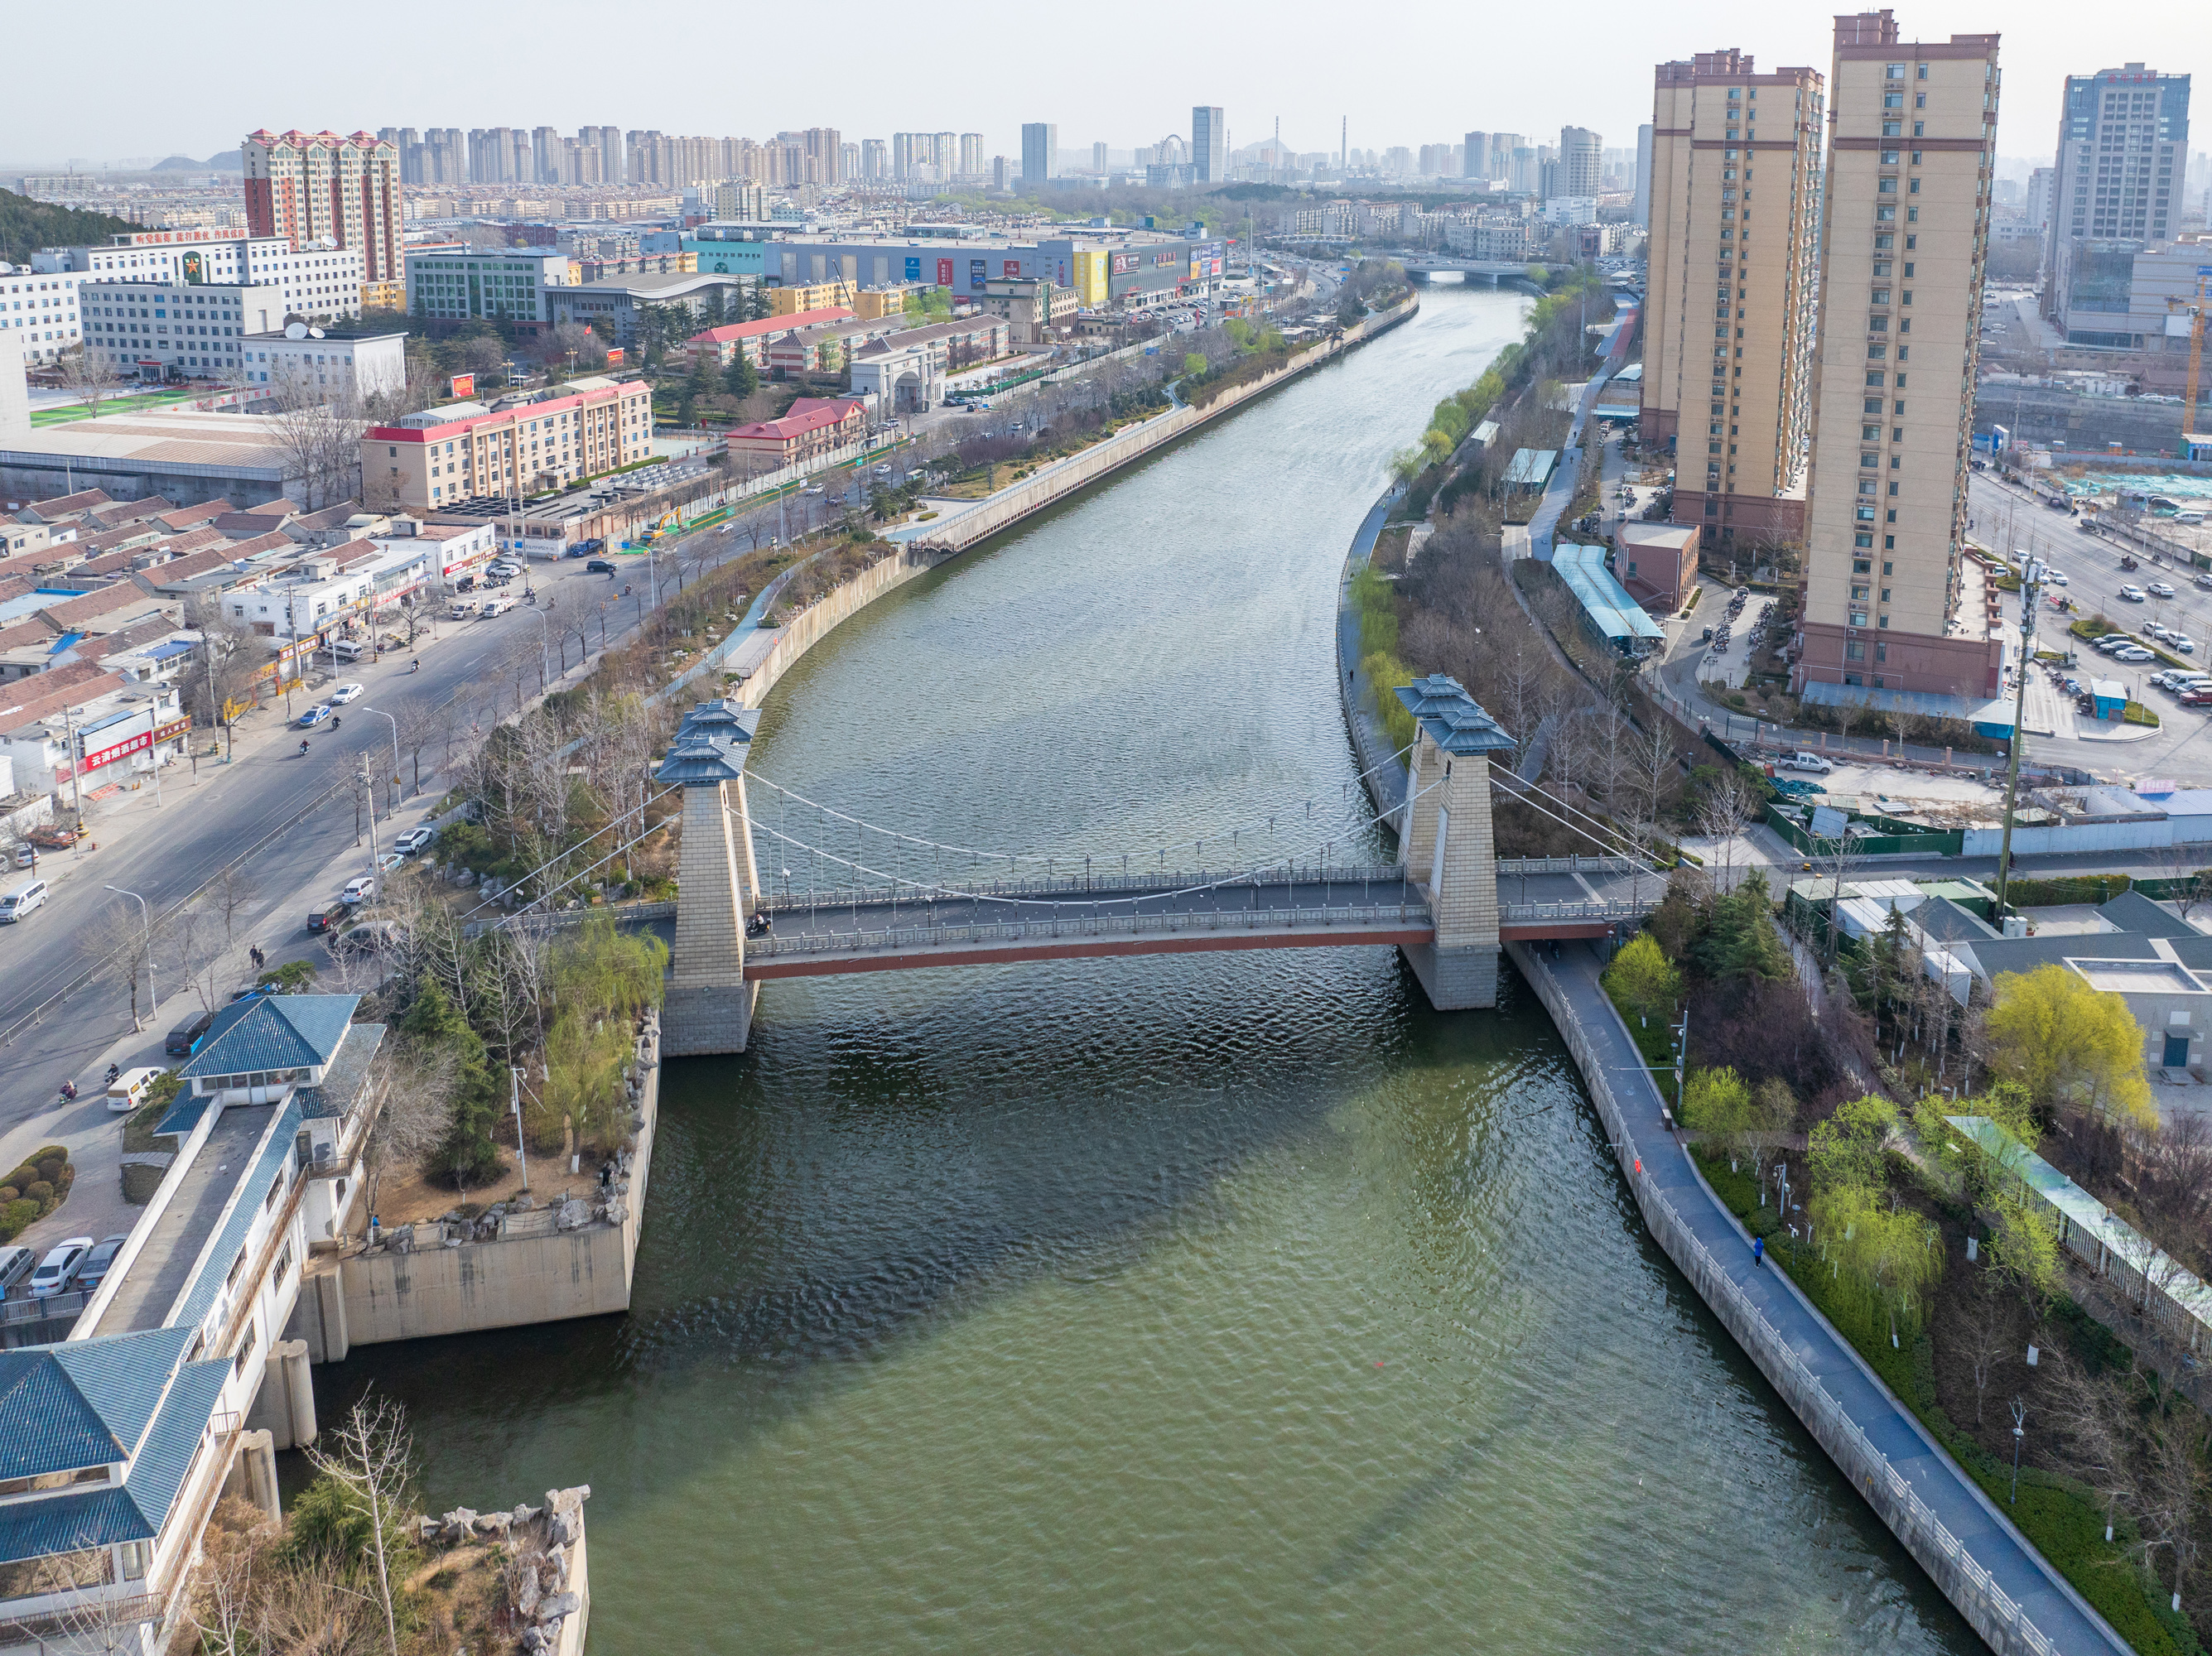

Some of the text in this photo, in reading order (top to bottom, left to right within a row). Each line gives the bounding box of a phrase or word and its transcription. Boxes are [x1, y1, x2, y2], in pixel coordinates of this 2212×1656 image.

[137, 229, 245, 244] 听党指挥 能打胜仗 作风优良
[91, 735, 148, 767] 云清烟酒超市
